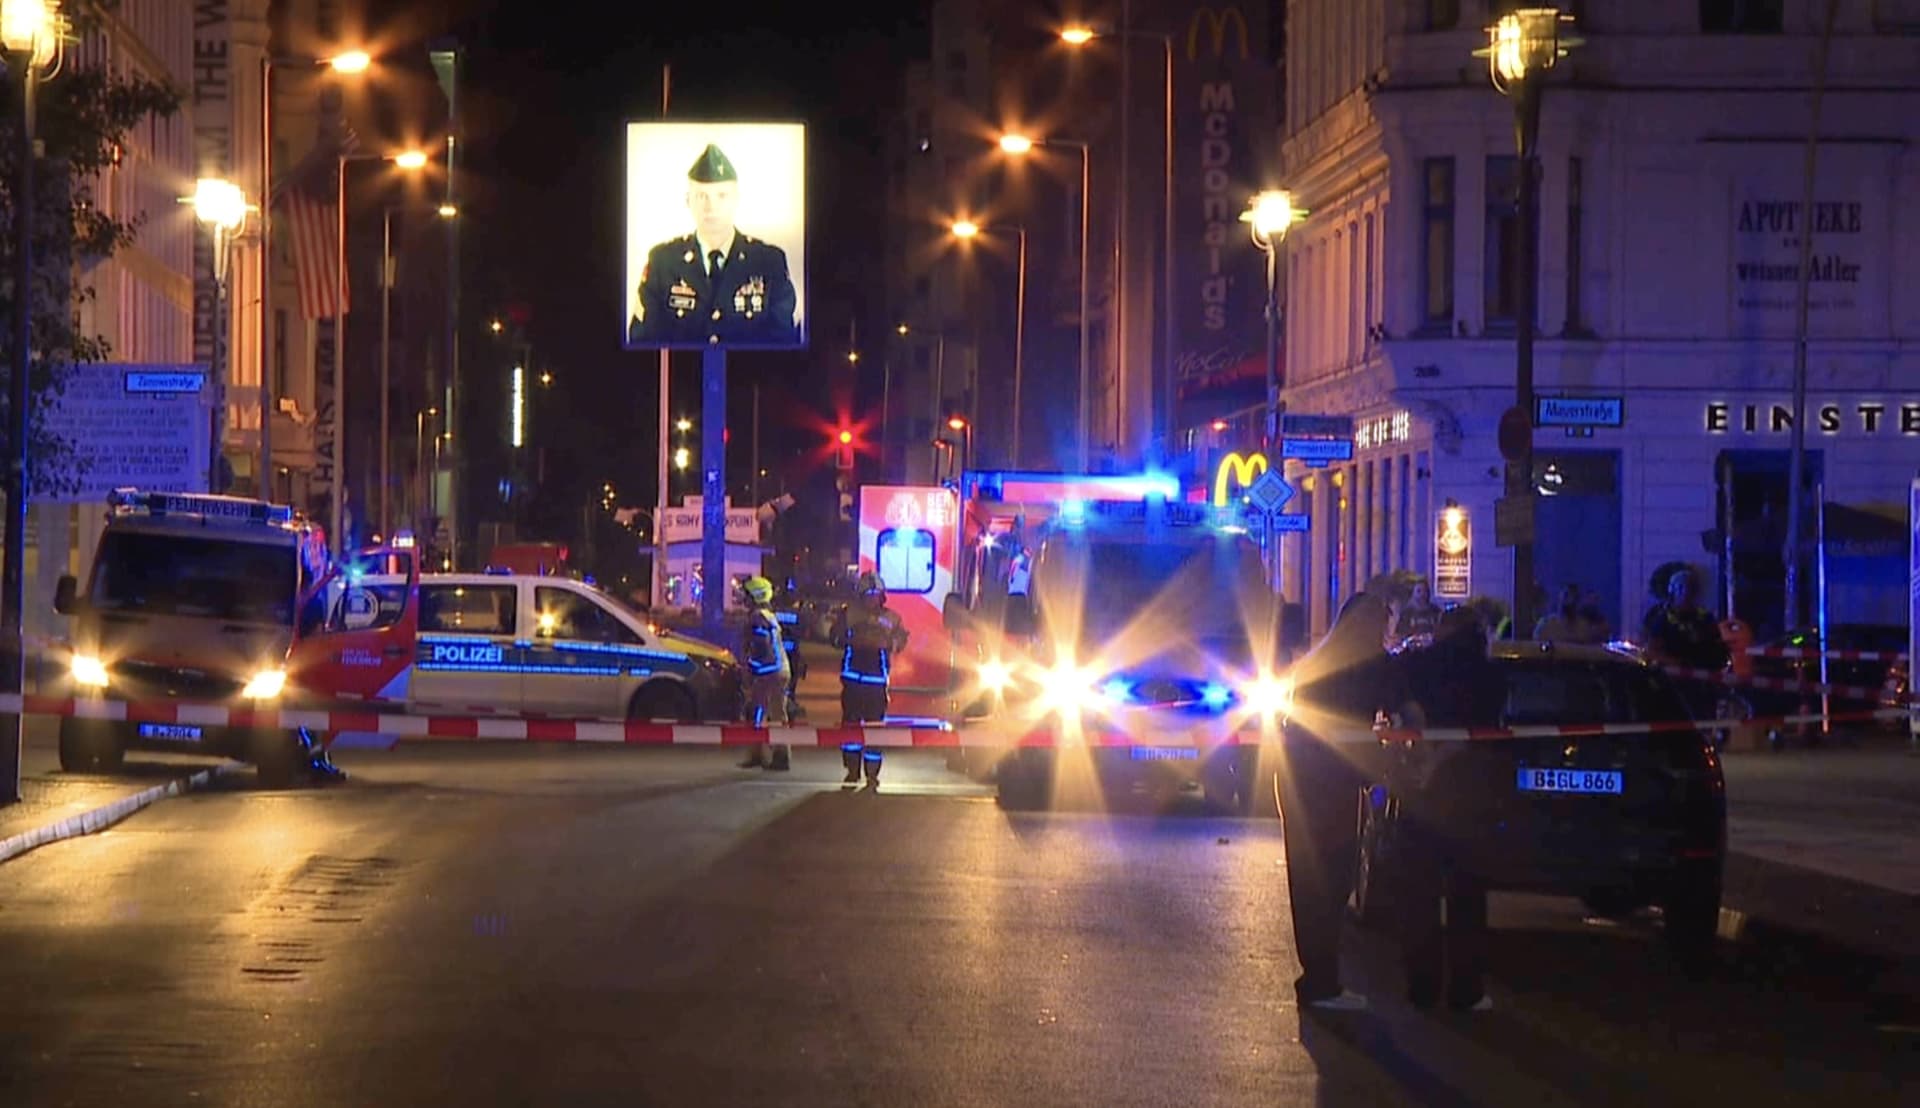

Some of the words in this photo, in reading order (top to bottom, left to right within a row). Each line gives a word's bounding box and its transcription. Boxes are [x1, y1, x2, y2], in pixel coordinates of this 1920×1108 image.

[193, 39, 228, 106] THE
[1200, 80, 1236, 331] McDonald's
[1737, 200, 1862, 233] APOTEKE
[1808, 253, 1862, 283] Adler
[166, 496, 253, 518] FEUERWEHR
[434, 644, 503, 663] POLIZEI
[1584, 773, 1615, 790] 866
